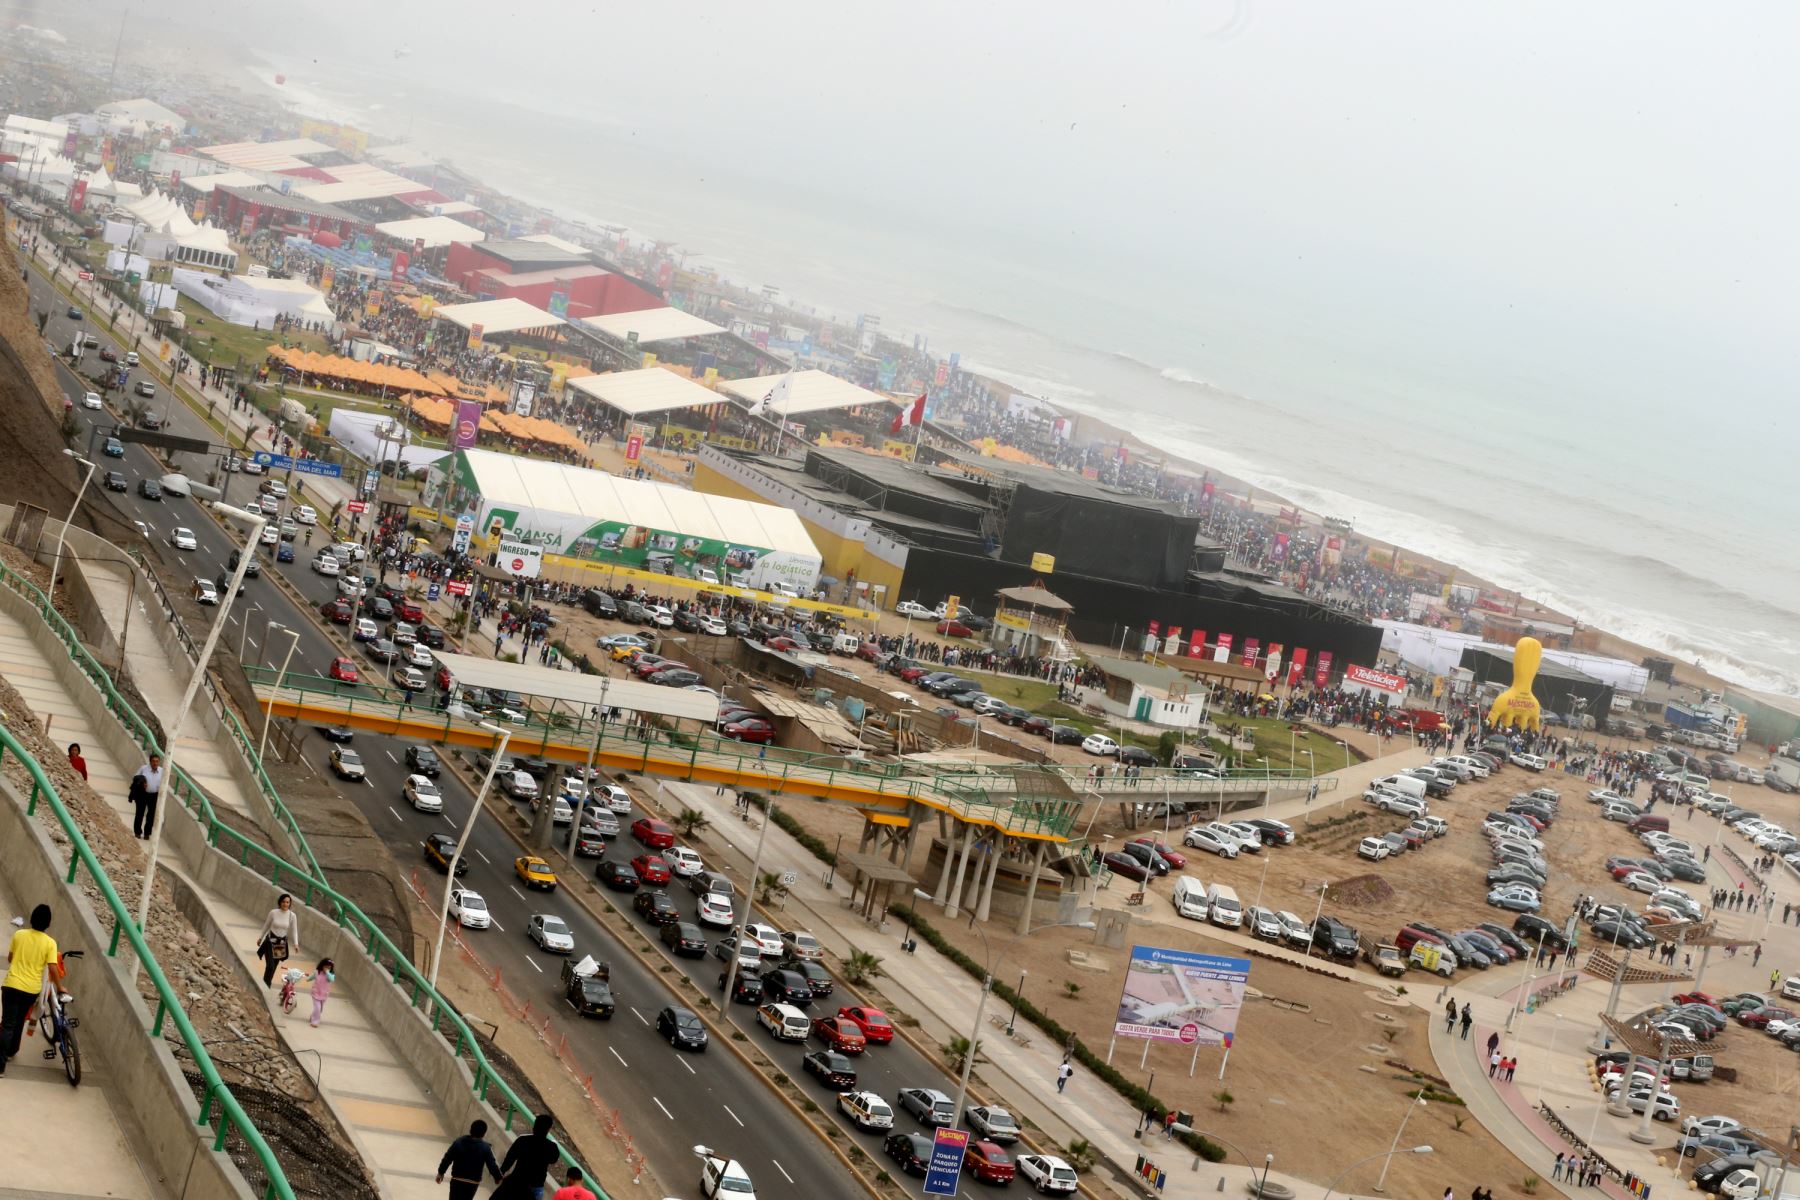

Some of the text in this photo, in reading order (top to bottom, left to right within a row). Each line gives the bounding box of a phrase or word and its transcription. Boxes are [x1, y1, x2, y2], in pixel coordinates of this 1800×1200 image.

[274, 460, 310, 472] MAGDLENA
[311, 466, 322, 474] DEL
[324, 468, 337, 477] MAR
[500, 544, 529, 556] INGRESO
[934, 1159, 958, 1167] PARQUEO
